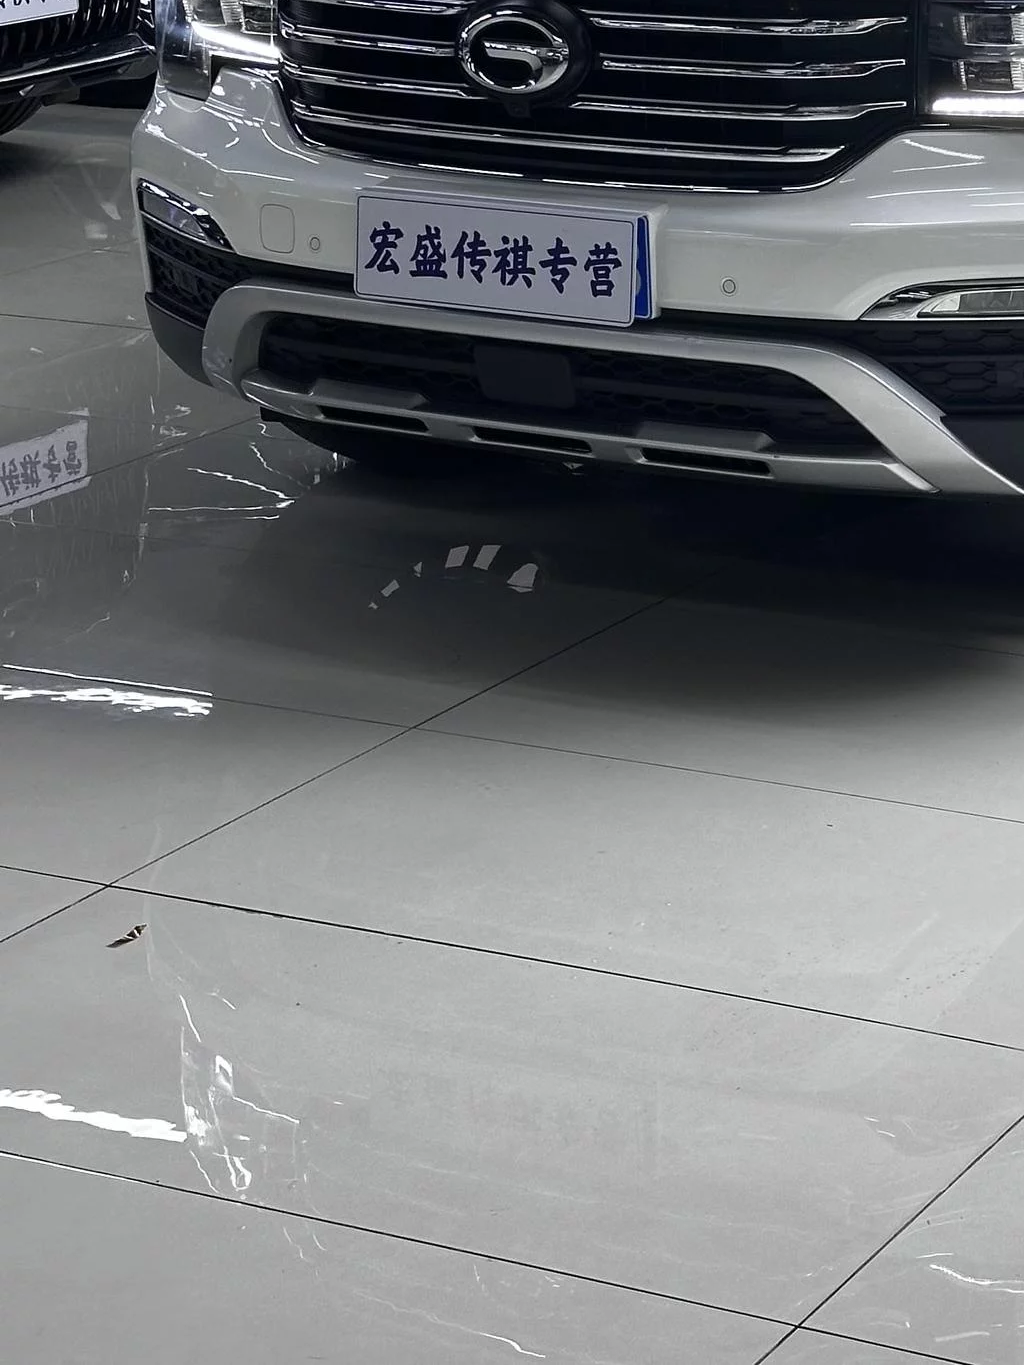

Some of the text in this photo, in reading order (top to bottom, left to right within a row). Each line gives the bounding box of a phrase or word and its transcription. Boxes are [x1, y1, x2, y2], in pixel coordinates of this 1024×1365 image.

[364, 218, 623, 298] 宏盛传祺专营
